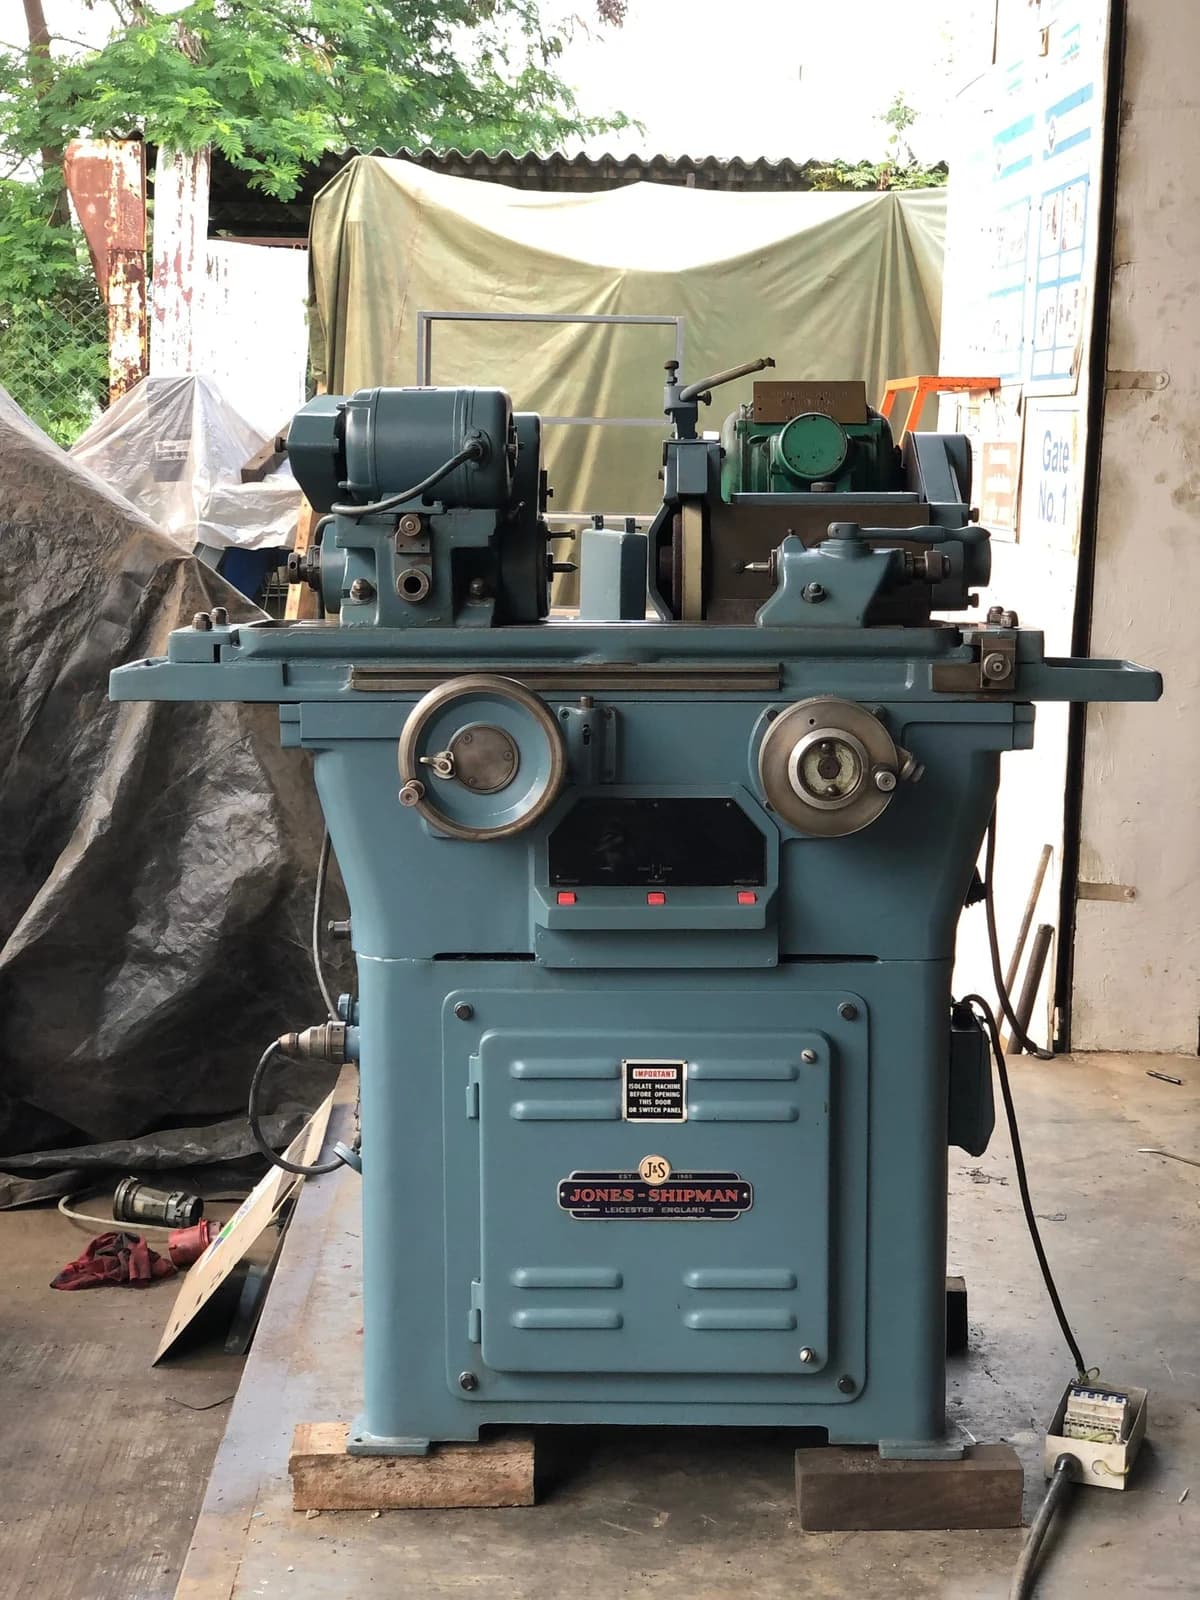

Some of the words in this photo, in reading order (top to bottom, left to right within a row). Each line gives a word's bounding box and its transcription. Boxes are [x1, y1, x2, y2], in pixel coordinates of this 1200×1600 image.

[1042, 429, 1070, 474] Gate
[635, 1070, 675, 1078] IMPORTANT
[644, 1161, 666, 1178] J&S
